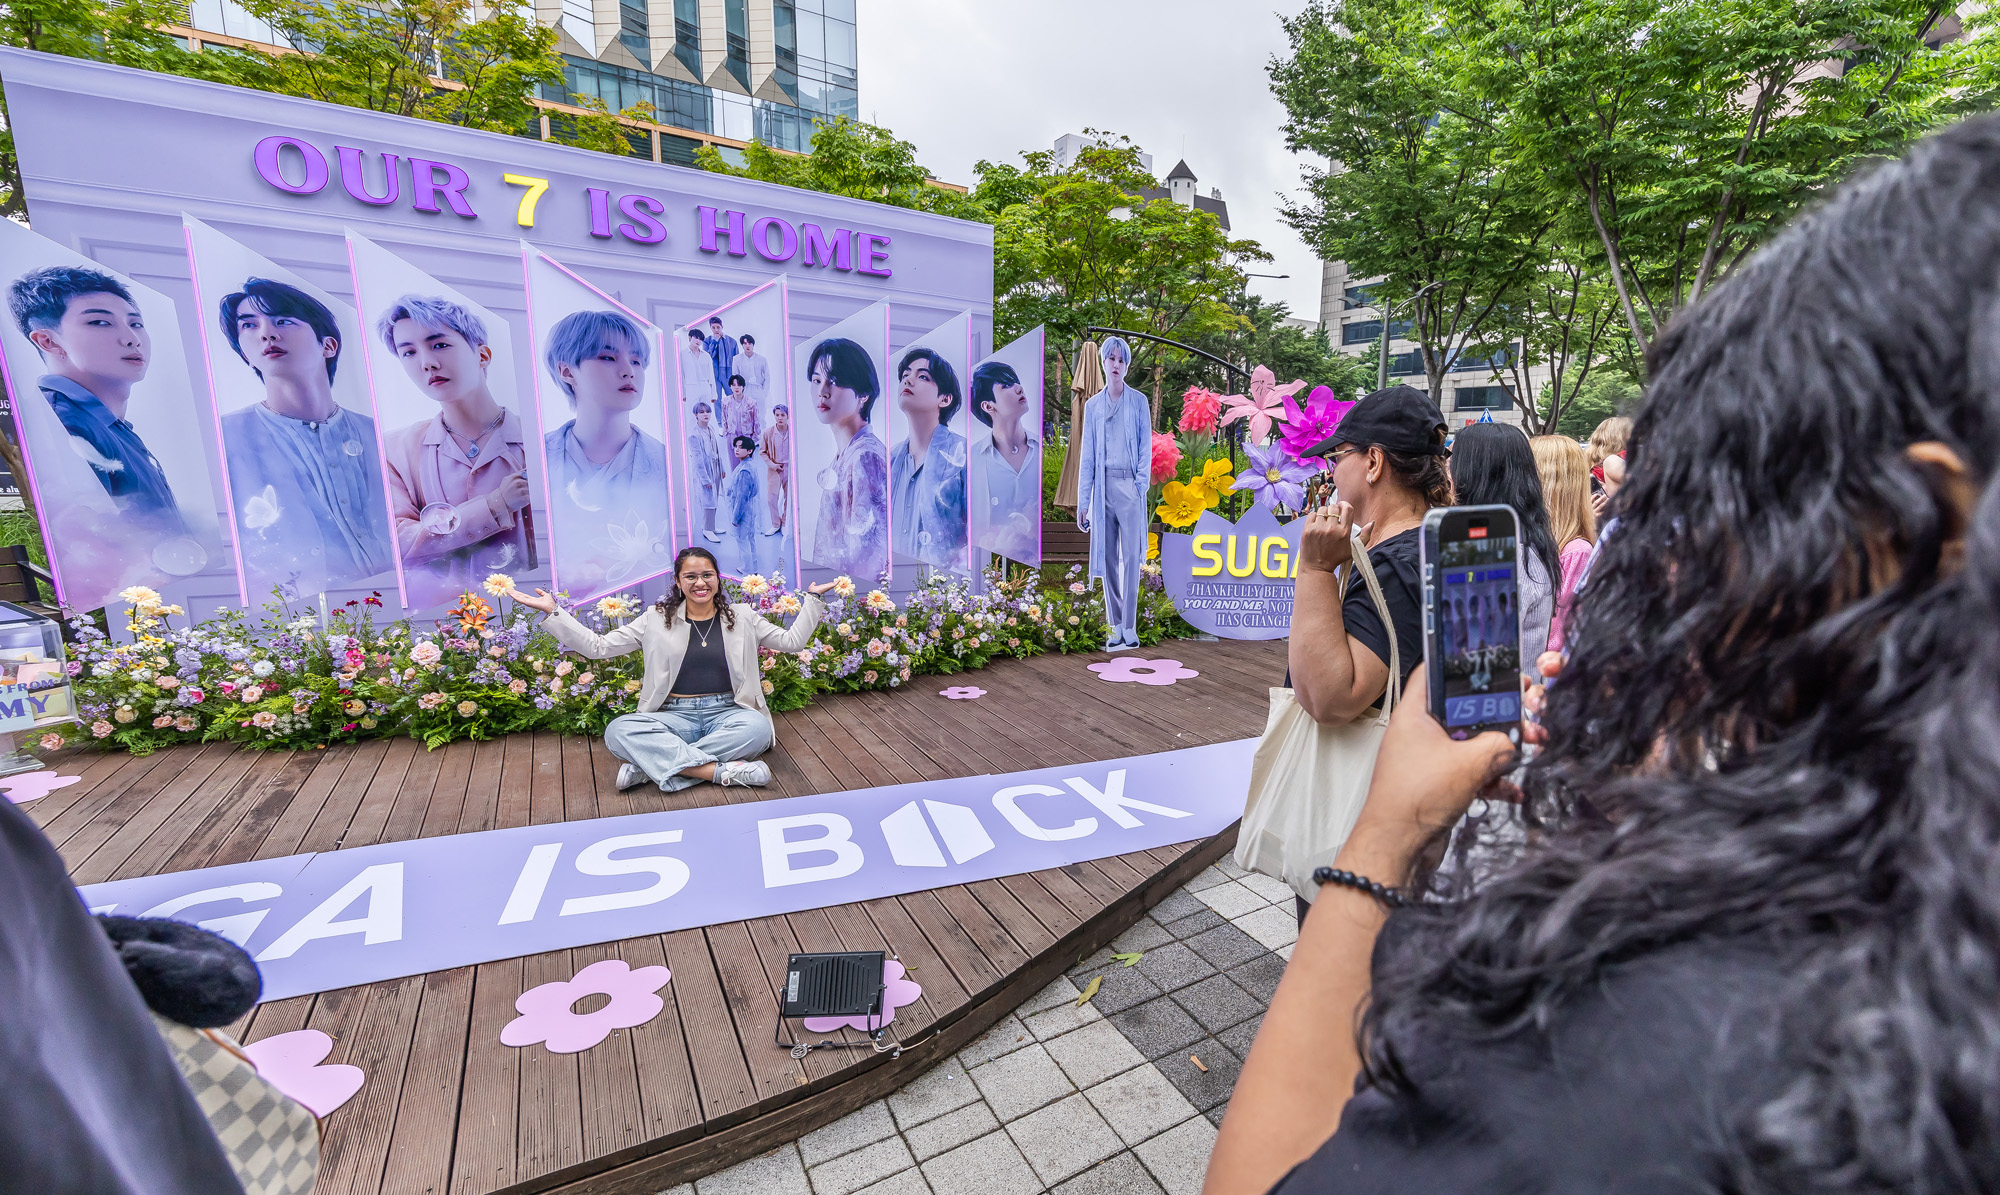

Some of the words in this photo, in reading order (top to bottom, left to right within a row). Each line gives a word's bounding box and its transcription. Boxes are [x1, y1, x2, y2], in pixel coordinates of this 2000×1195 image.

[254, 135, 478, 218] OUR
[503, 172, 549, 227] 7
[586, 187, 668, 243] IS
[697, 204, 893, 277] HOME
[1187, 582, 1261, 598] THANKFULLY
[1183, 599, 1212, 609] YOU
[1212, 600, 1240, 610] AND
[1241, 601, 1267, 613] ME,
[1216, 613, 1240, 627] HAS
[7, 679, 54, 694] FROM
[497, 829, 690, 925] IS
